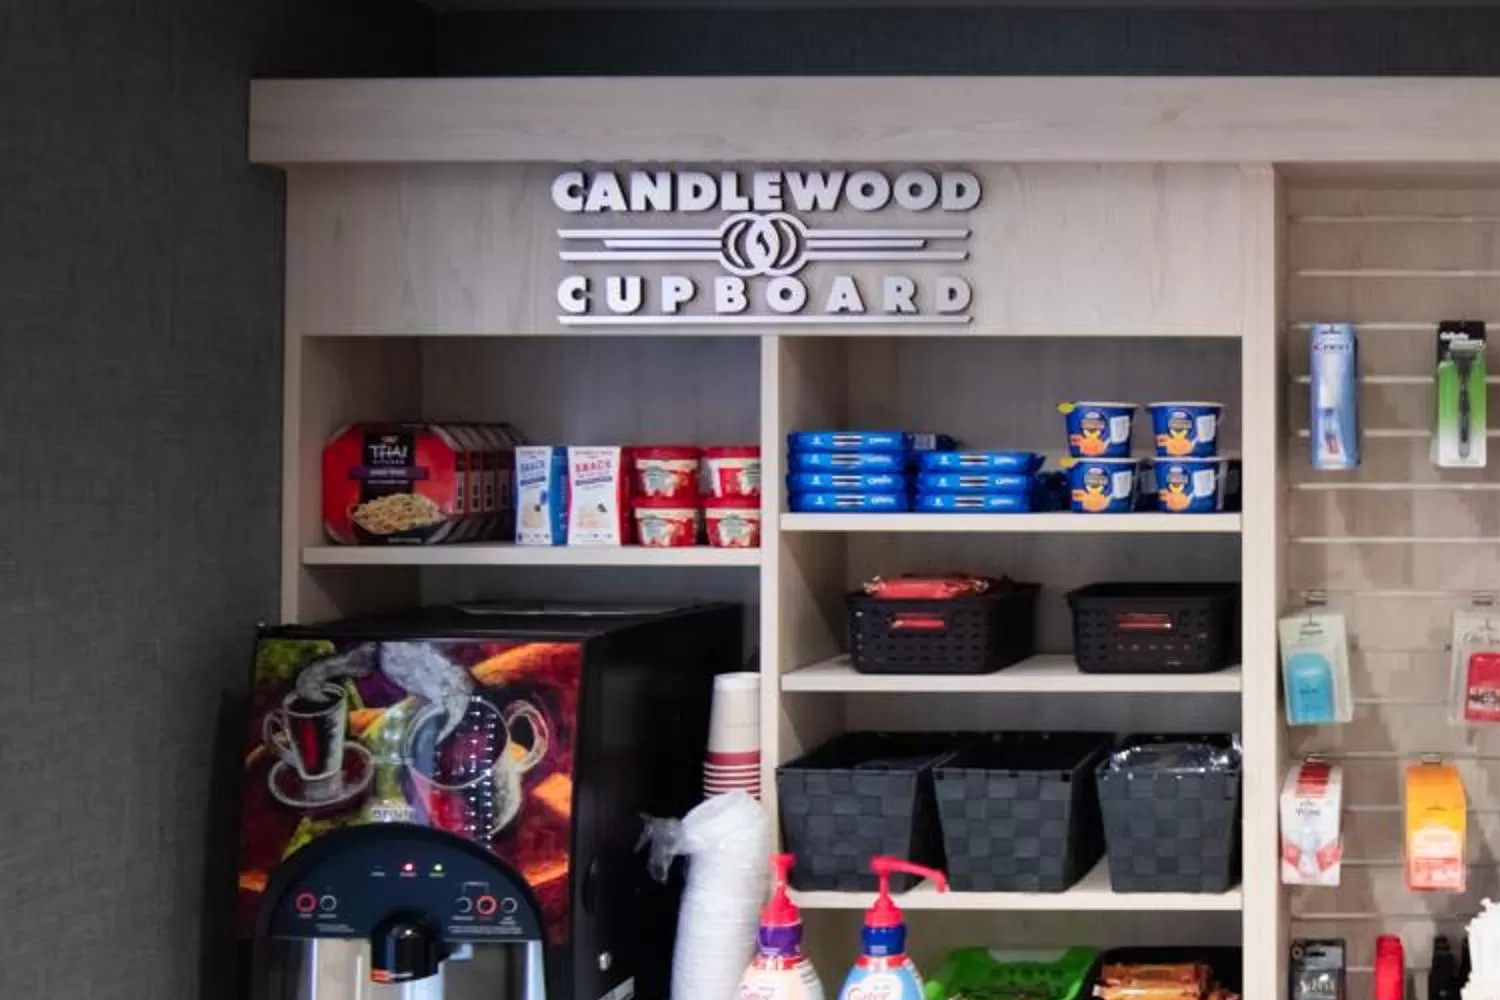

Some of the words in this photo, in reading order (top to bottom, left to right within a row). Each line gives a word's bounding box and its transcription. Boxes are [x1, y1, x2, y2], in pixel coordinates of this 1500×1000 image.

[551, 170, 982, 212] CANDLEWOOD
[556, 276, 973, 314] CUPBOARD
[368, 445, 408, 458] THAI
